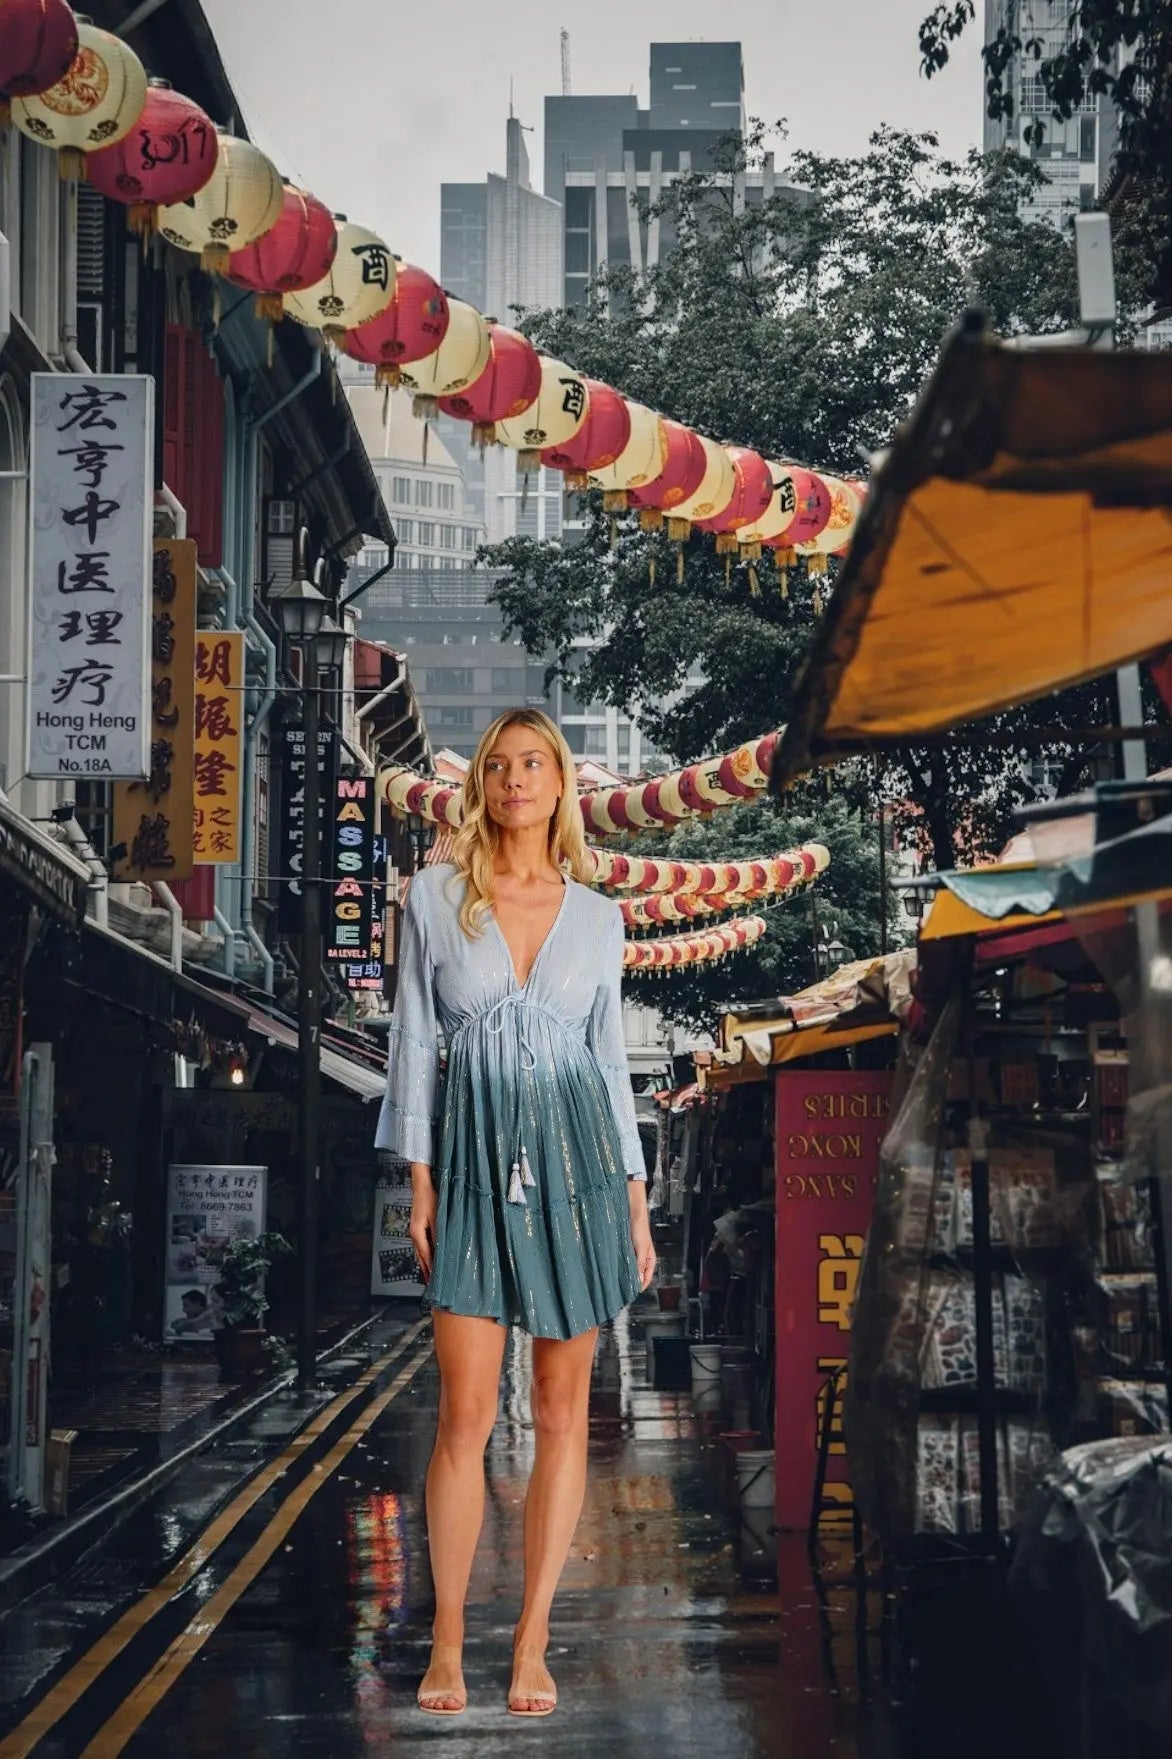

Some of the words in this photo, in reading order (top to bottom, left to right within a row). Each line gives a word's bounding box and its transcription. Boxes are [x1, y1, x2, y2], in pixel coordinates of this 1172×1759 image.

[352, 244, 390, 292] 酉
[36, 712, 83, 730] Hong
[89, 712, 136, 730] Heng
[65, 735, 106, 751] TCM
[58, 757, 112, 772] No.18A
[335, 781, 367, 945] MASSAGE
[788, 1134, 862, 1158] KONG
[232, 1190, 254, 1199] TCM
[784, 1174, 856, 1199] SANG
